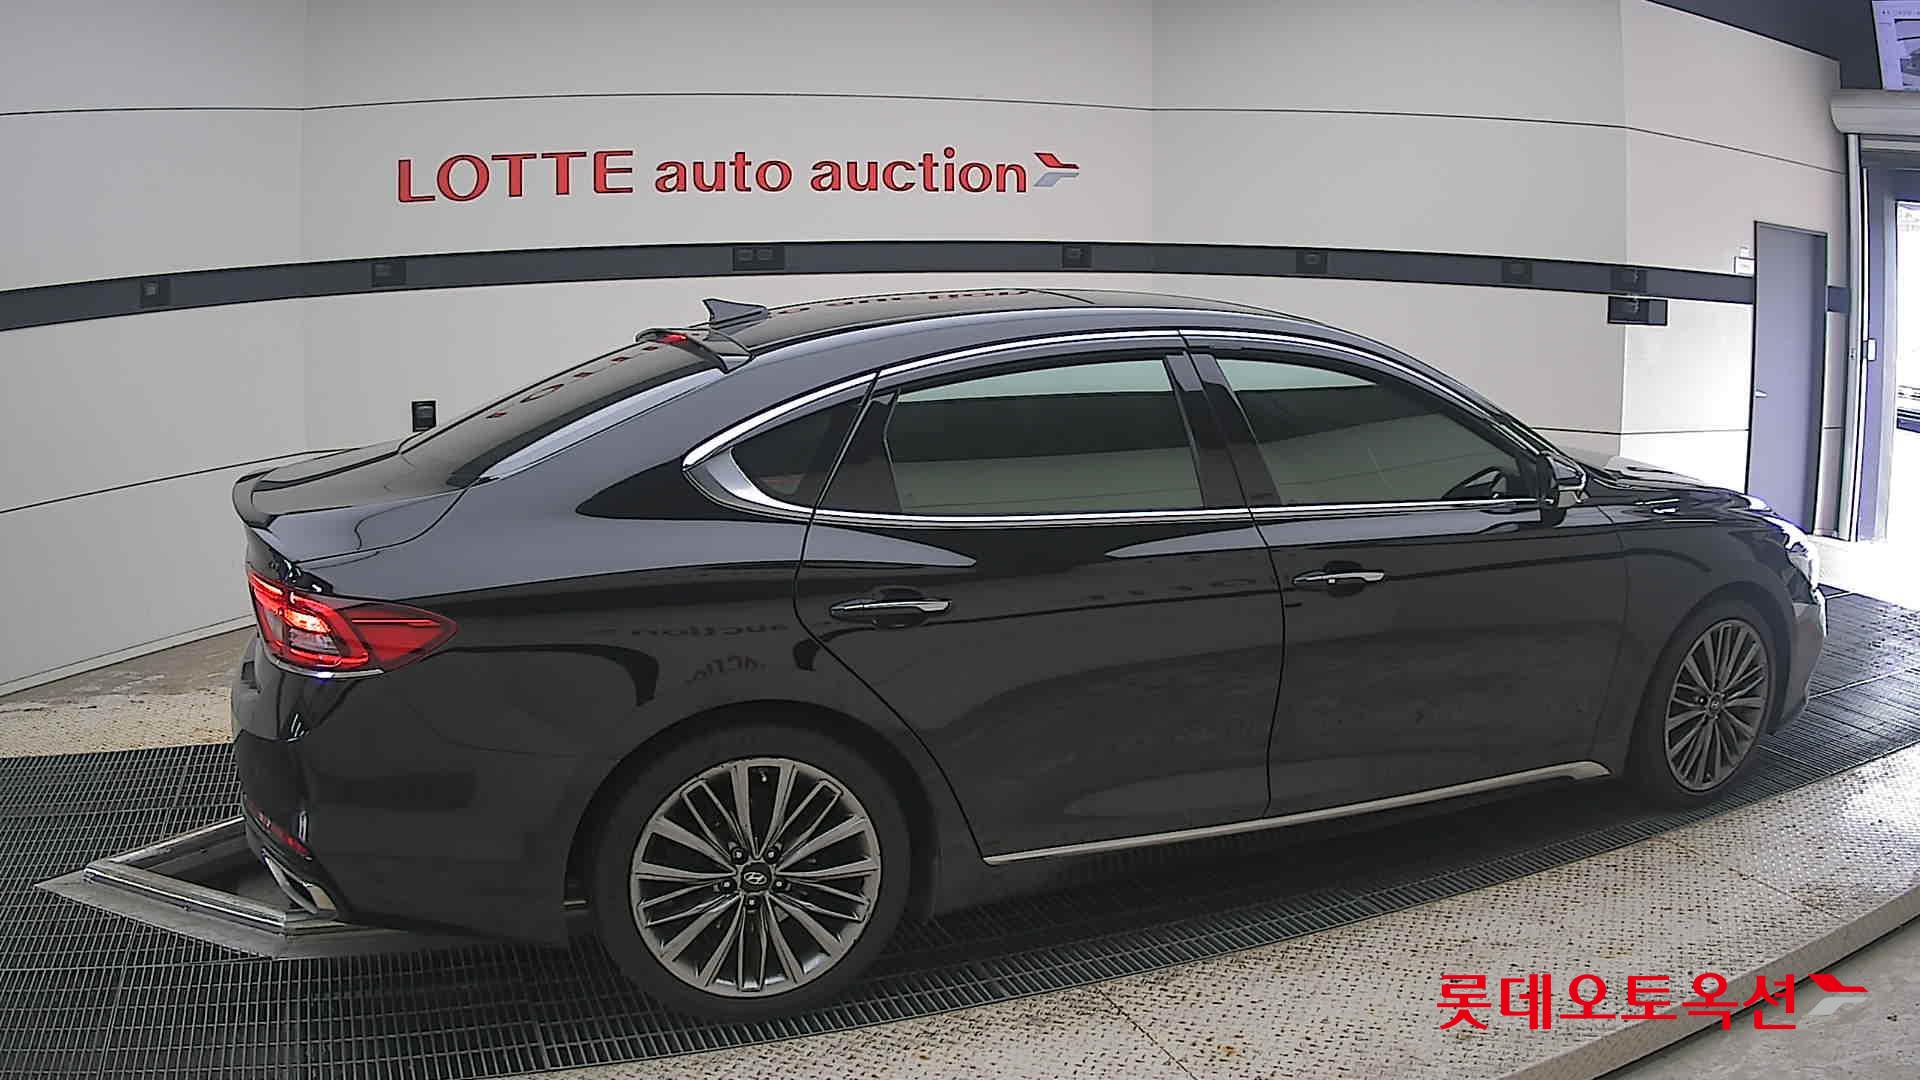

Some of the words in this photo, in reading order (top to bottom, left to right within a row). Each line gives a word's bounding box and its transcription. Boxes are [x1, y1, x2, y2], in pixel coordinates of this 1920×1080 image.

[398, 150, 633, 202] LOTTE
[655, 151, 792, 192] auto
[810, 147, 1027, 193] auction
